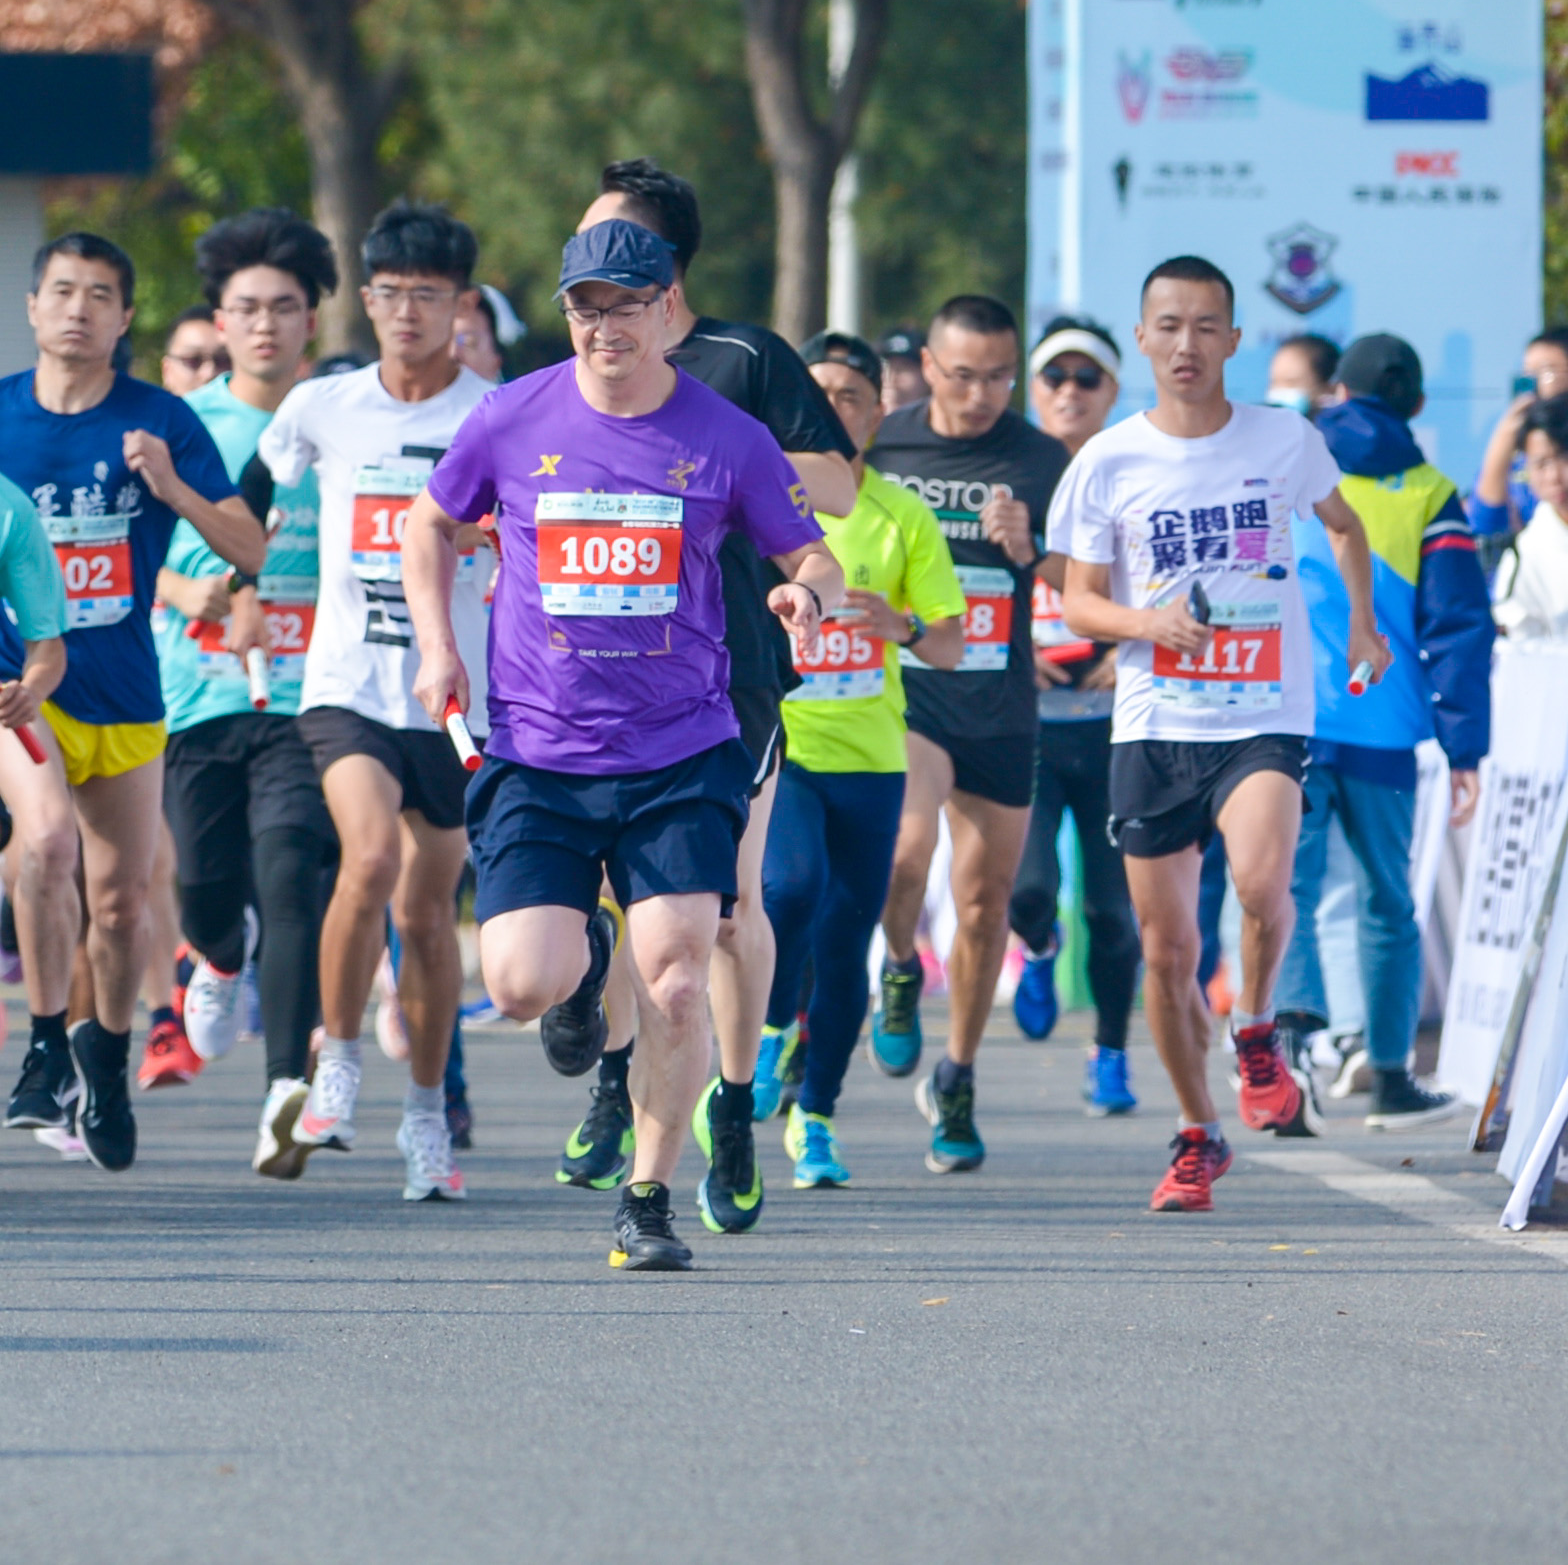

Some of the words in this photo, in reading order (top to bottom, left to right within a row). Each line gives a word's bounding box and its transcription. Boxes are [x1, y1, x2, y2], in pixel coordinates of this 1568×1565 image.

[1147, 499, 1271, 543] 企鹅跑
[65, 555, 114, 592] 02
[560, 536, 663, 576] 1089
[599, 649, 620, 658] YOUR
